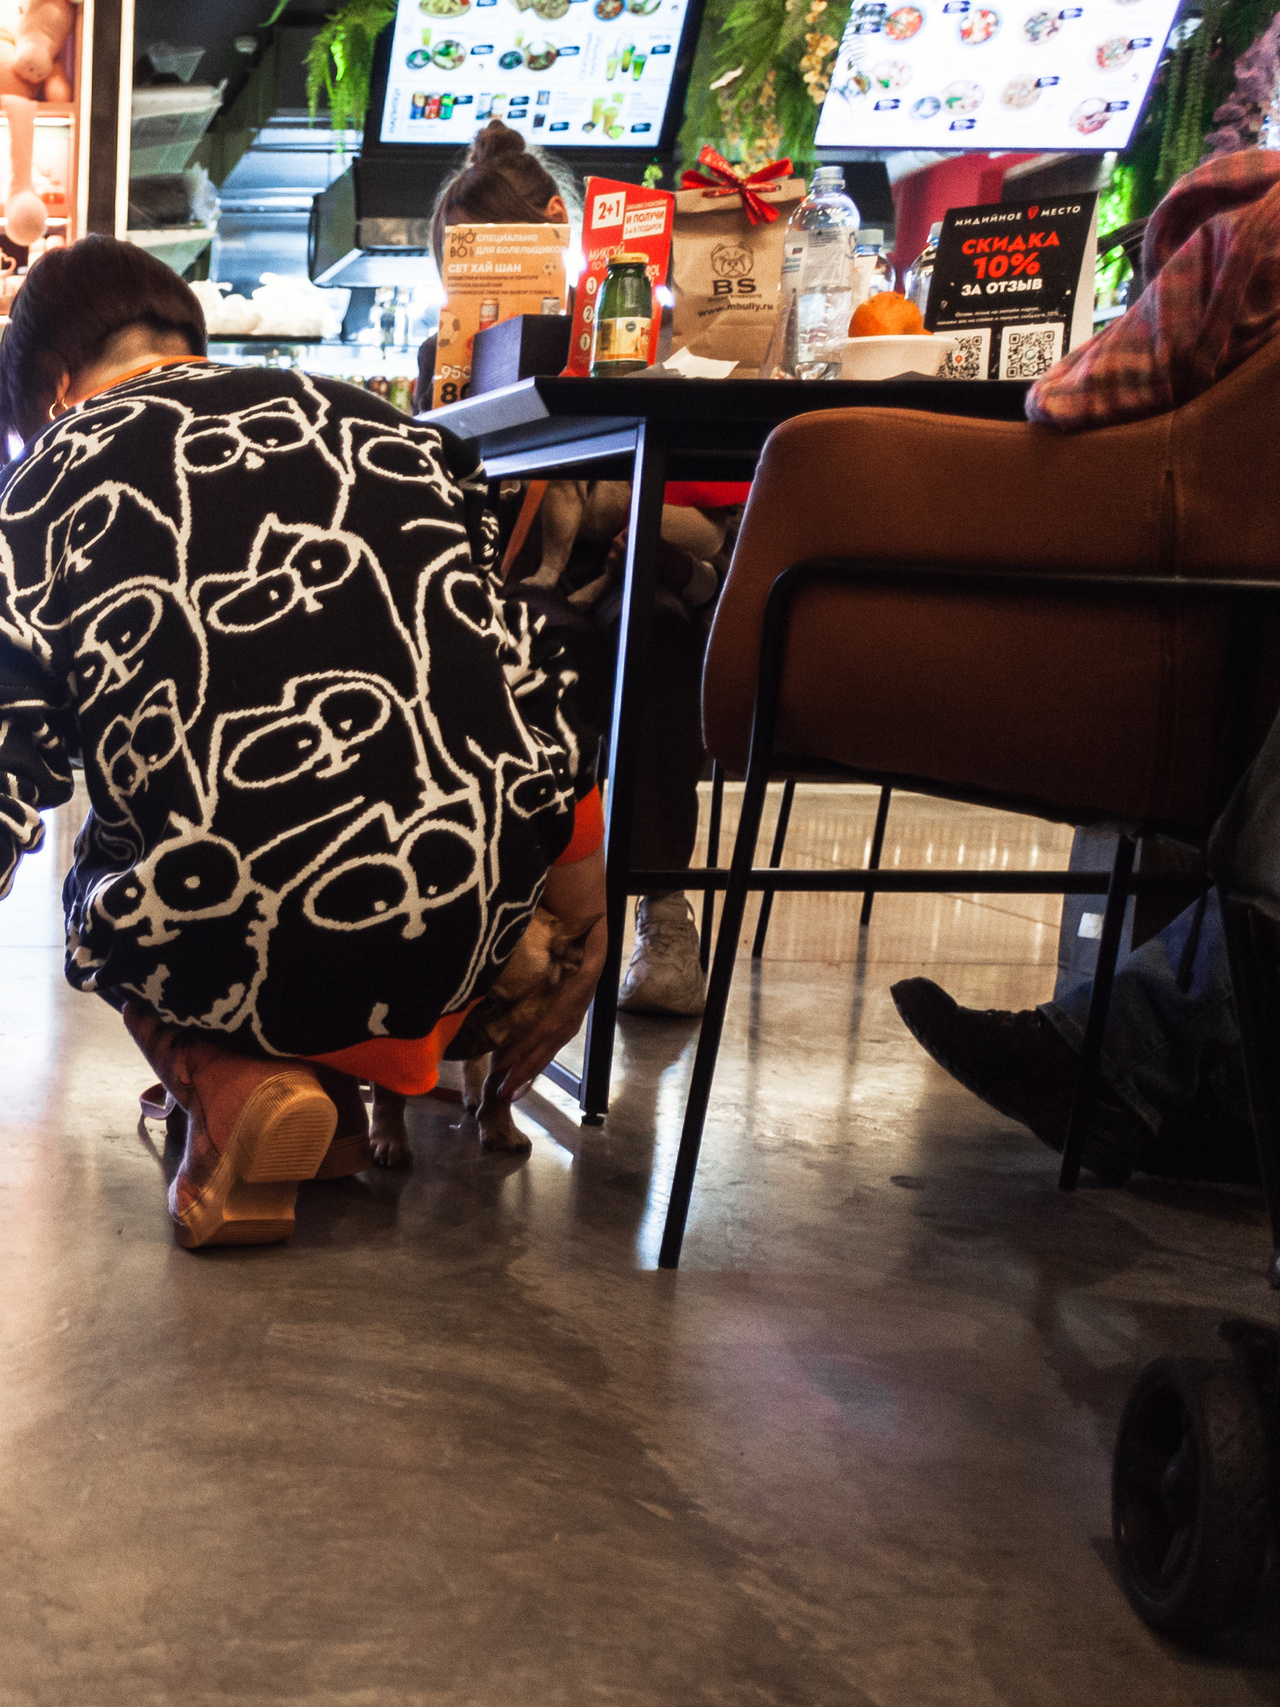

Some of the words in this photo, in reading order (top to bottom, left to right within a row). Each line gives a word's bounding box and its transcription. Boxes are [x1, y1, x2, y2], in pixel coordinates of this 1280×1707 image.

[598, 199, 621, 221] 2+1
[954, 212, 1022, 227] МИДИЙНОЕ
[1041, 205, 1081, 217] МЕСТО
[476, 233, 538, 243] СПЕЦИАЛЬНО
[961, 230, 1060, 255] СКИДКА
[475, 246, 495, 256] ДЛЯ
[496, 245, 563, 255] БОЛЕЛЬЩИКО
[447, 263, 468, 273] СЕТ
[470, 261, 494, 273] ХАЙ
[495, 263, 522, 273] ШАН
[973, 252, 1040, 279] 10%
[713, 278, 756, 295] BS
[961, 284, 982, 296] ЗА
[985, 278, 1043, 294] ОТЗЫВ
